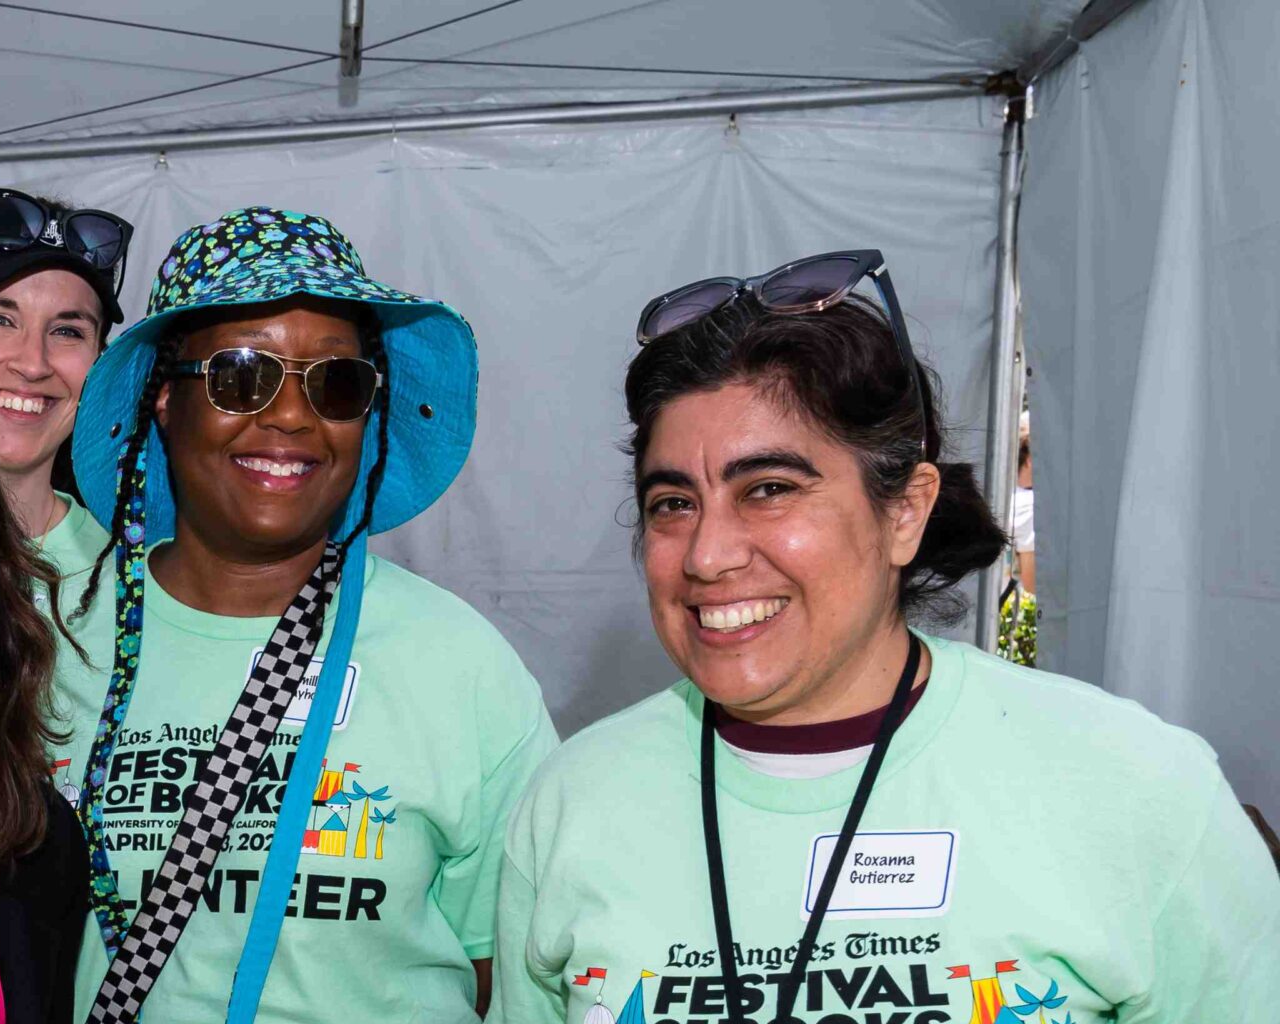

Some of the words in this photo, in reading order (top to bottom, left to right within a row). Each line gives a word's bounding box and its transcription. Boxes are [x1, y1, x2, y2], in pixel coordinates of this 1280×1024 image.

[156, 723, 223, 747] Angel
[105, 782, 147, 806] OF
[236, 819, 277, 830] CALIFOR
[238, 833, 273, 852] 202
[853, 852, 916, 867] Roxanna
[849, 870, 916, 885] Gutierrez
[664, 943, 717, 969] Los
[844, 931, 942, 960] Times
[653, 963, 950, 1016] FESTIVAL
